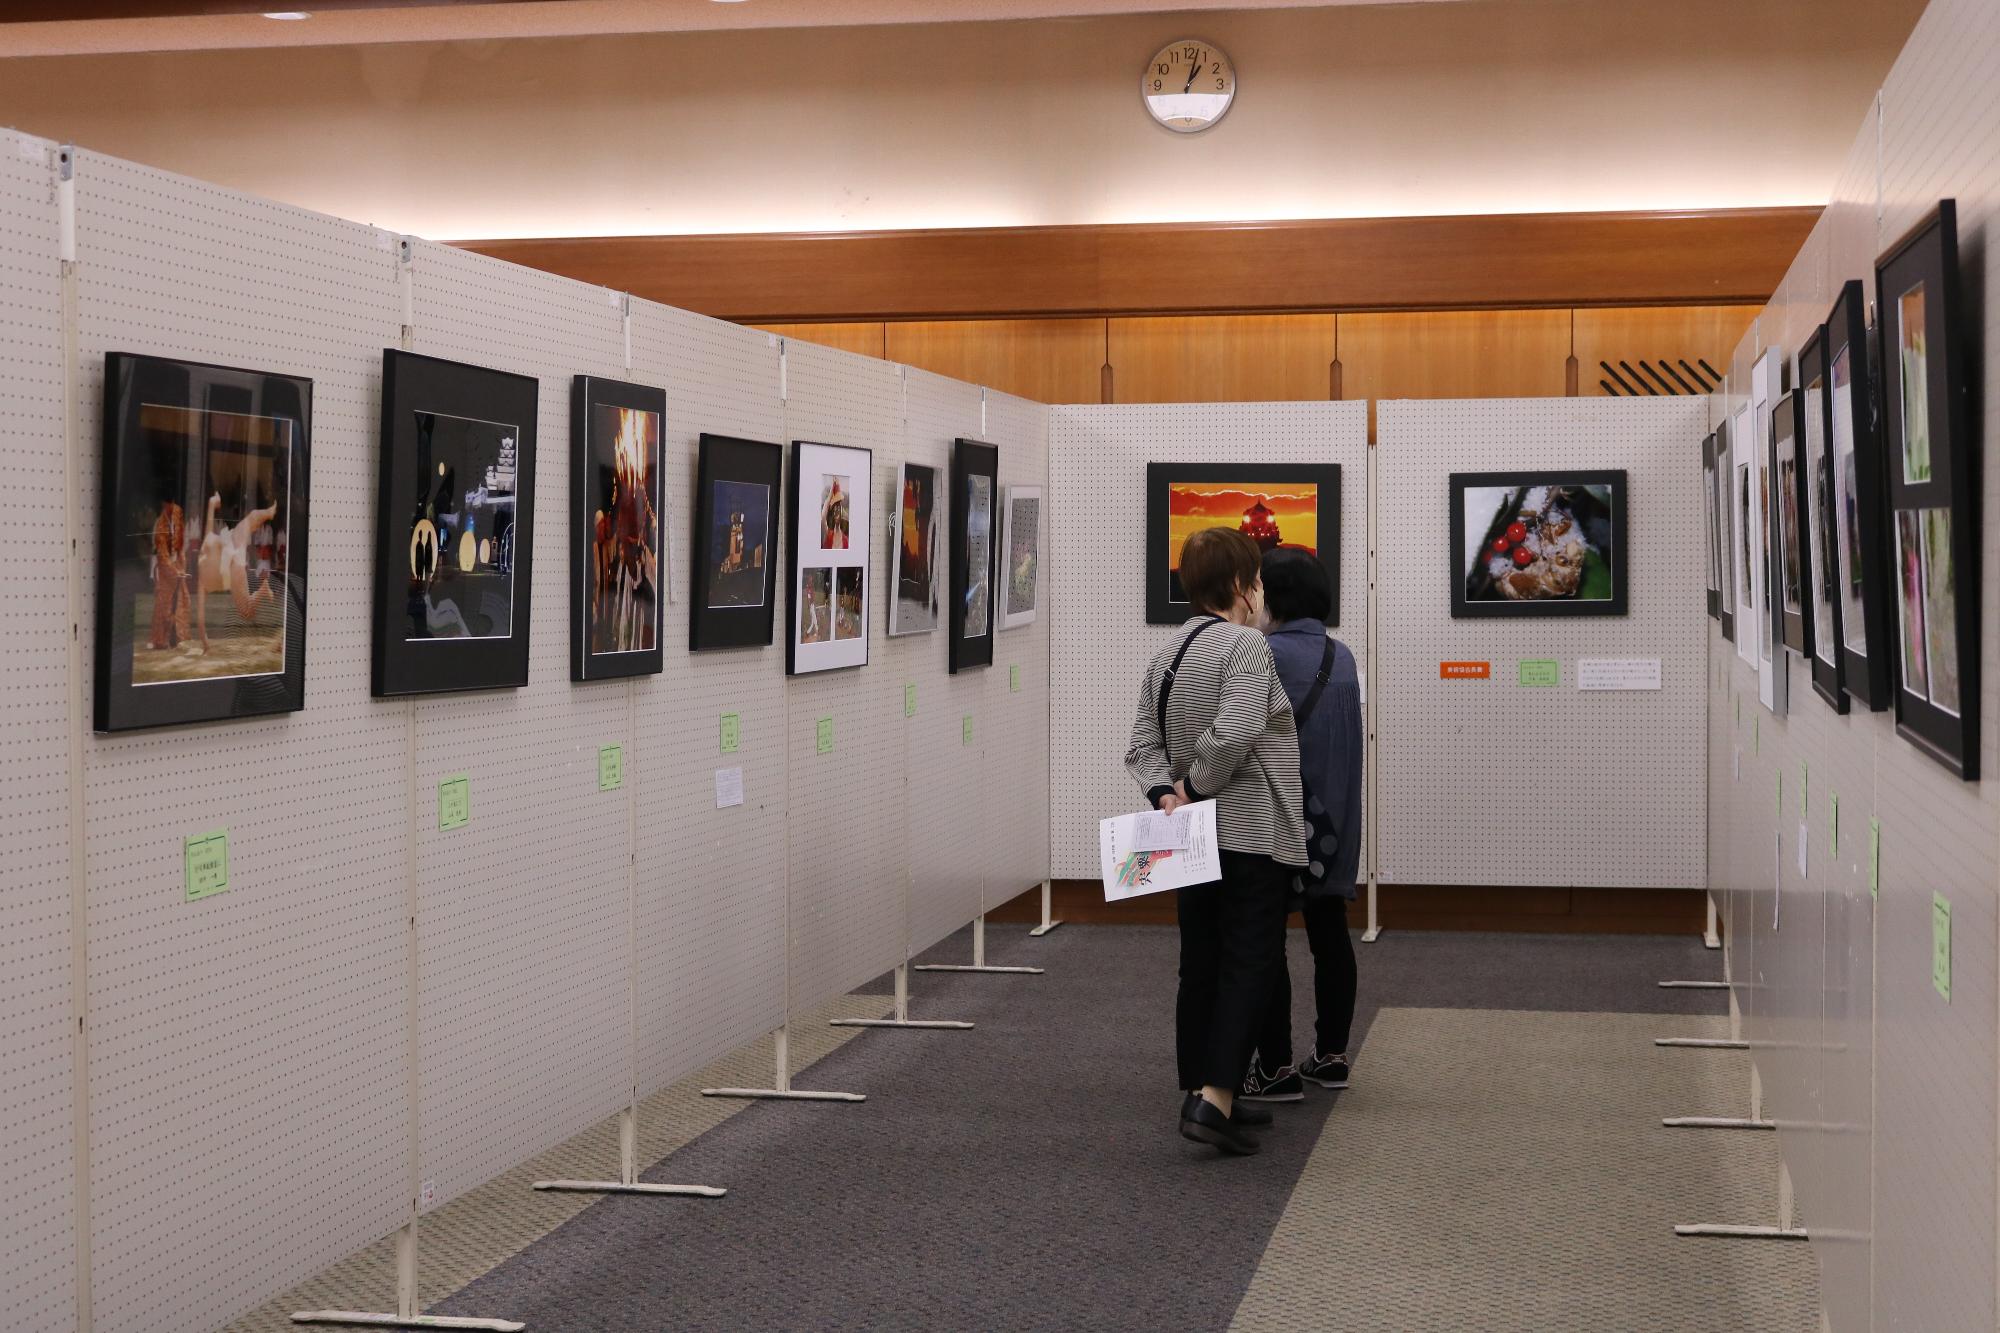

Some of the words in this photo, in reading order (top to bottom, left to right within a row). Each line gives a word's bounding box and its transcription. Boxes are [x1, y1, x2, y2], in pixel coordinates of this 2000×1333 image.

[1170, 52, 1179, 64] 11
[1183, 47, 1195, 59] 12
[1202, 51, 1207, 63] 1
[1157, 63, 1170, 75] 10
[1212, 62, 1220, 74] 2
[1153, 79, 1162, 91] 9
[1216, 78, 1224, 90] 3
